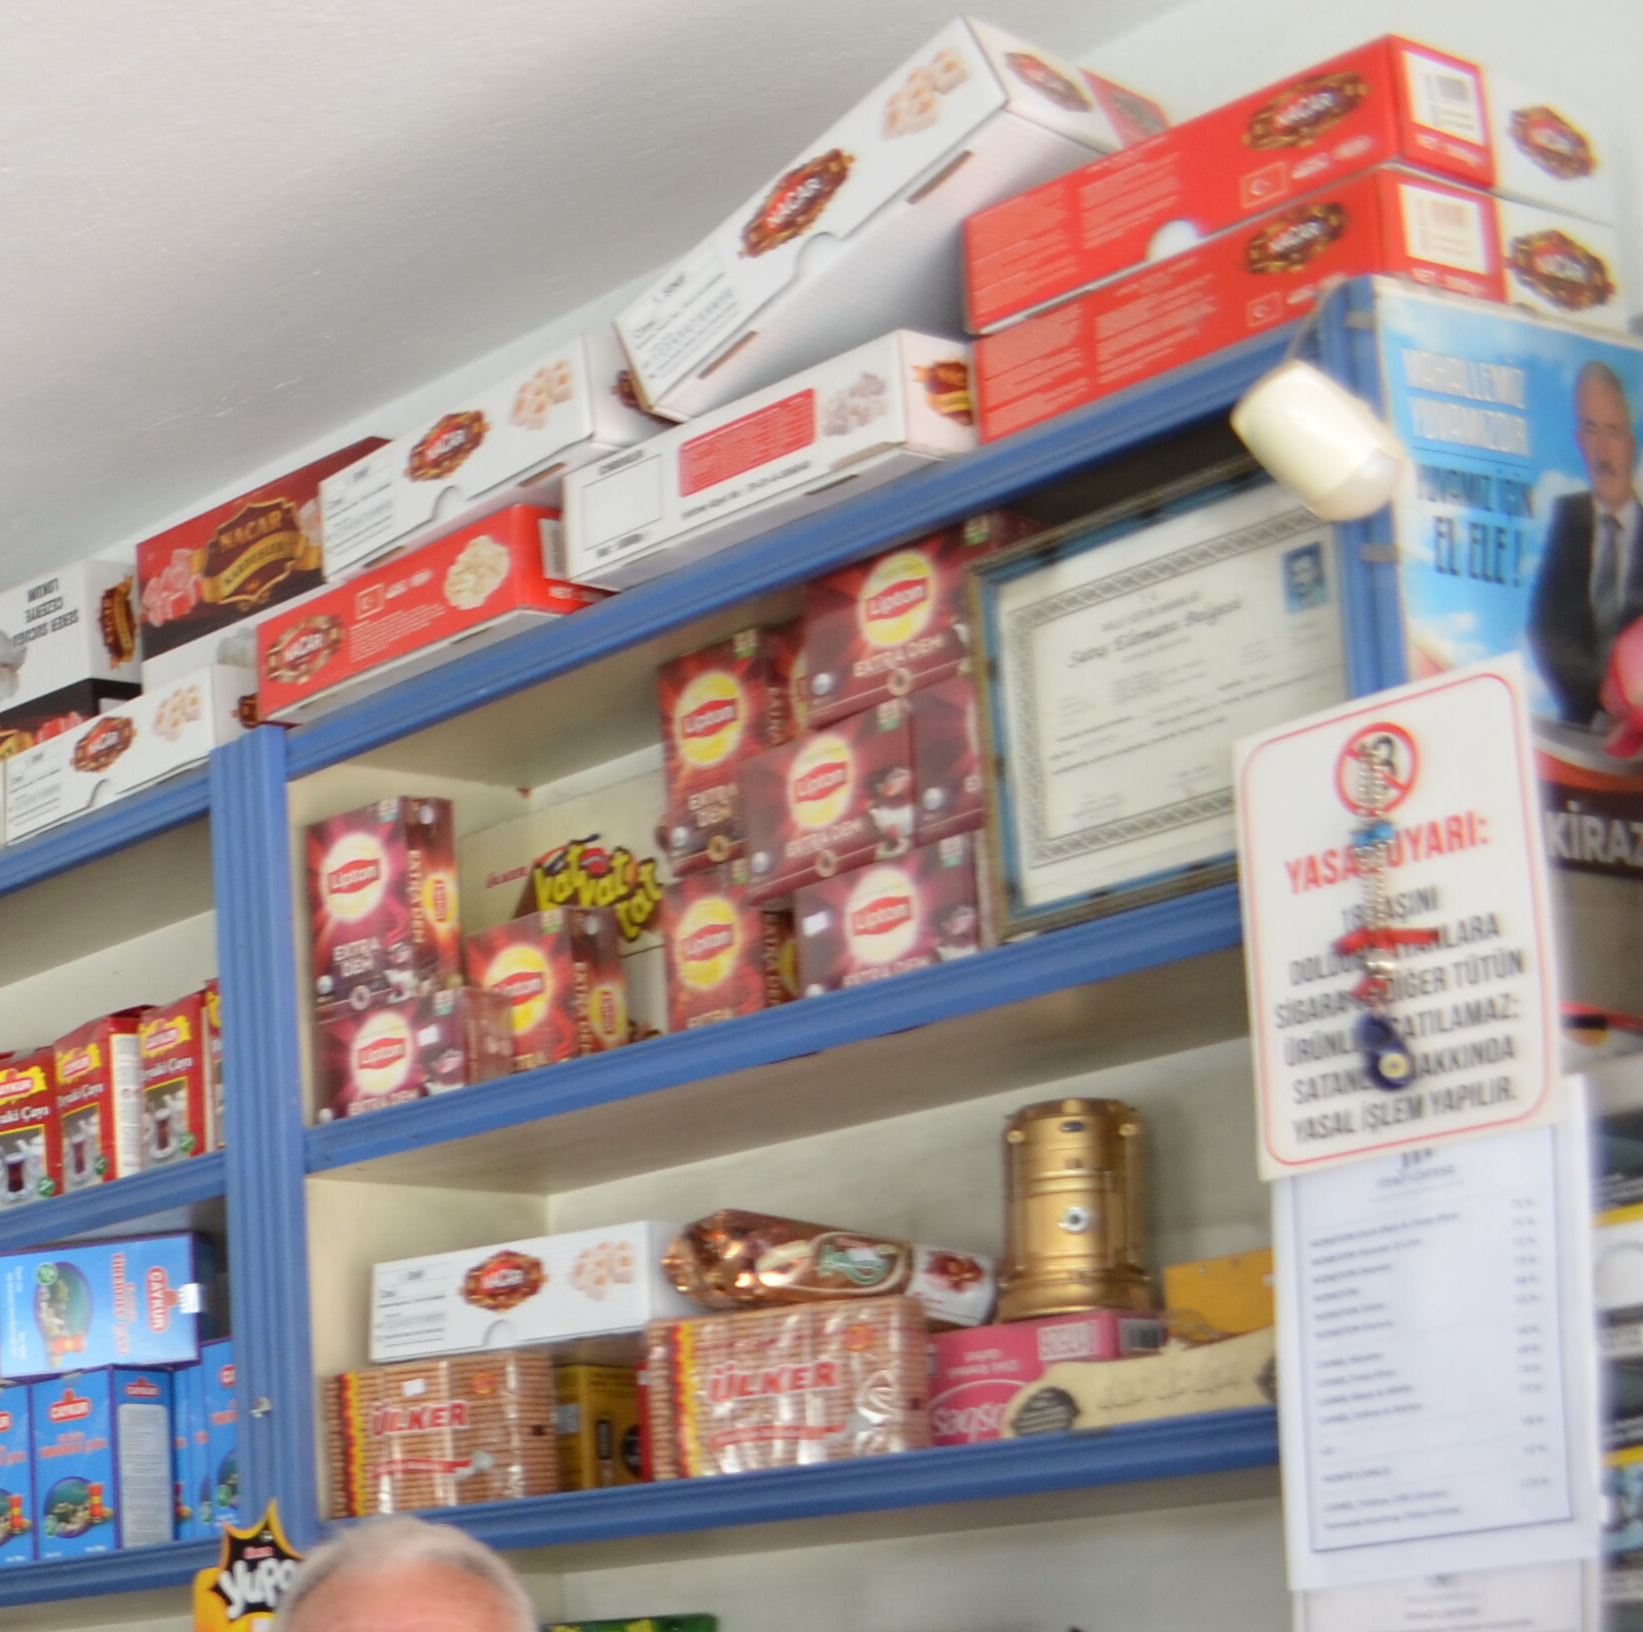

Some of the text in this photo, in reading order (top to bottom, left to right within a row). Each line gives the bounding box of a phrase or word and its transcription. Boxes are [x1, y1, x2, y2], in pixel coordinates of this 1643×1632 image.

[865, 582, 928, 621] Lipton
[683, 702, 737, 736] Lipton
[853, 901, 911, 931] Lipton
[1453, 946, 1526, 988] TÜTÜN
[1292, 1113, 1356, 1145] YASAL
[1361, 1092, 1424, 1136] İŞLEM
[708, 1362, 839, 1403] ÜLKER
[370, 1401, 470, 1436] ÜLKER
